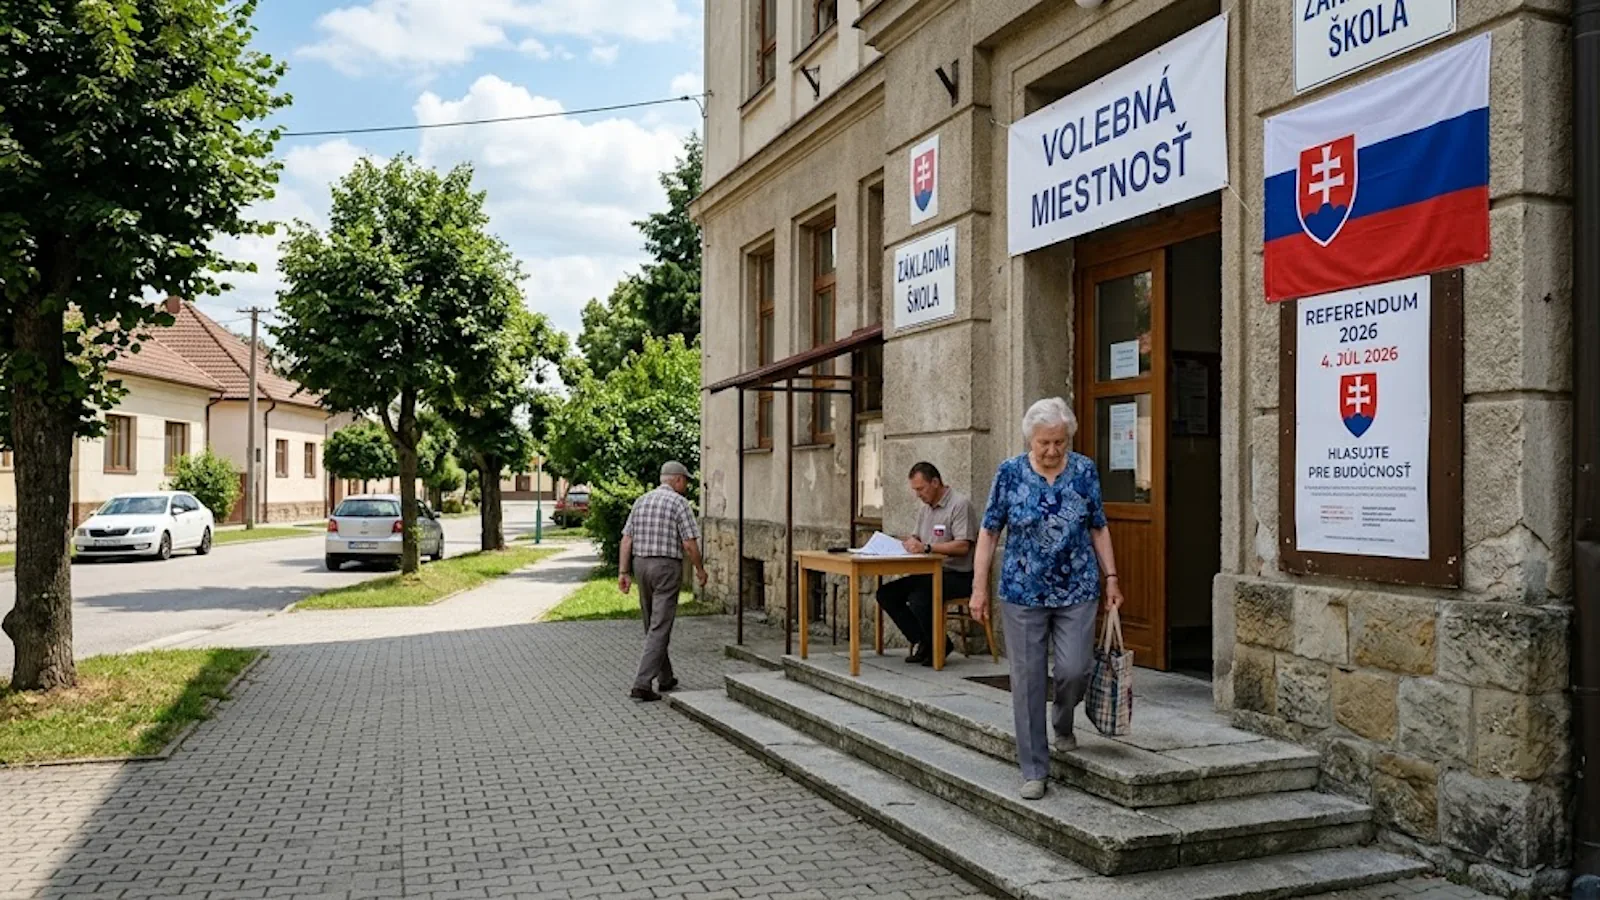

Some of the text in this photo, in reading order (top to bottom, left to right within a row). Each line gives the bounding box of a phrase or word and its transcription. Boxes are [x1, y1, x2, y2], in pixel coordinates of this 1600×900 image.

[1329, 0, 1409, 57] ŠKOLA
[1042, 64, 1176, 167] VOLEBNÁ
[1032, 121, 1192, 228] MIESTNOSŤ
[898, 238, 950, 283] ZÁKLADNÁ
[907, 282, 940, 313] ŠKOLA
[1305, 292, 1418, 326] REFERENDUM
[1339, 322, 1378, 343] 2026
[1320, 346, 1399, 368] 4. JÚL 2026
[1328, 446, 1389, 460] HLASUJTE
[1308, 461, 1411, 479] PRE BUDÚCNOSŤ
